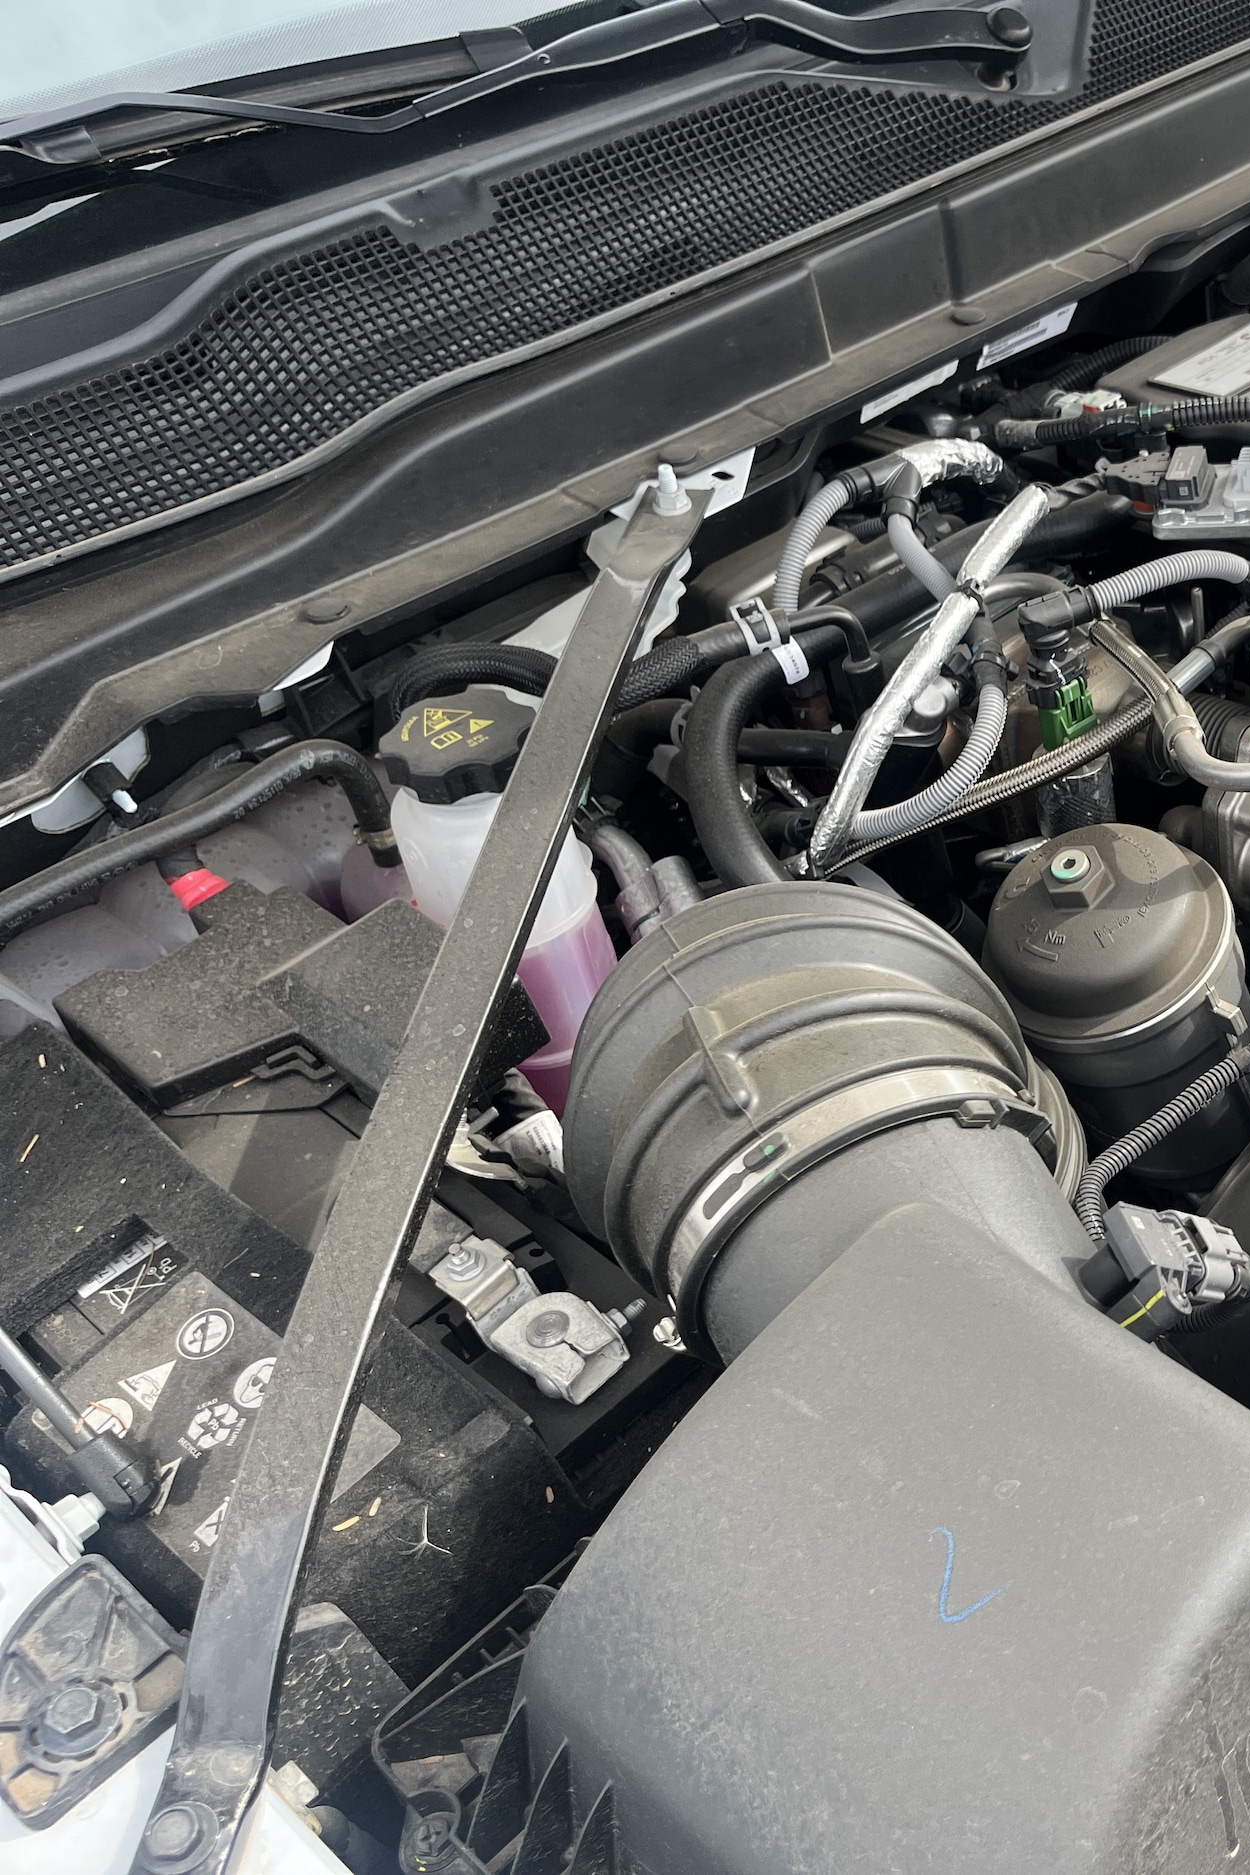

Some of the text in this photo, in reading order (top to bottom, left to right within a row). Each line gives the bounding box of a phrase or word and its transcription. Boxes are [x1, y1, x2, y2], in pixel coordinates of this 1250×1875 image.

[1044, 930, 1066, 946] Nm
[160, 1257, 178, 1274] Pb
[196, 1398, 219, 1410] LEAD
[208, 1418, 220, 1431] Pb
[177, 1436, 203, 1460] RECYCLE
[188, 1540, 201, 1554] Pb
